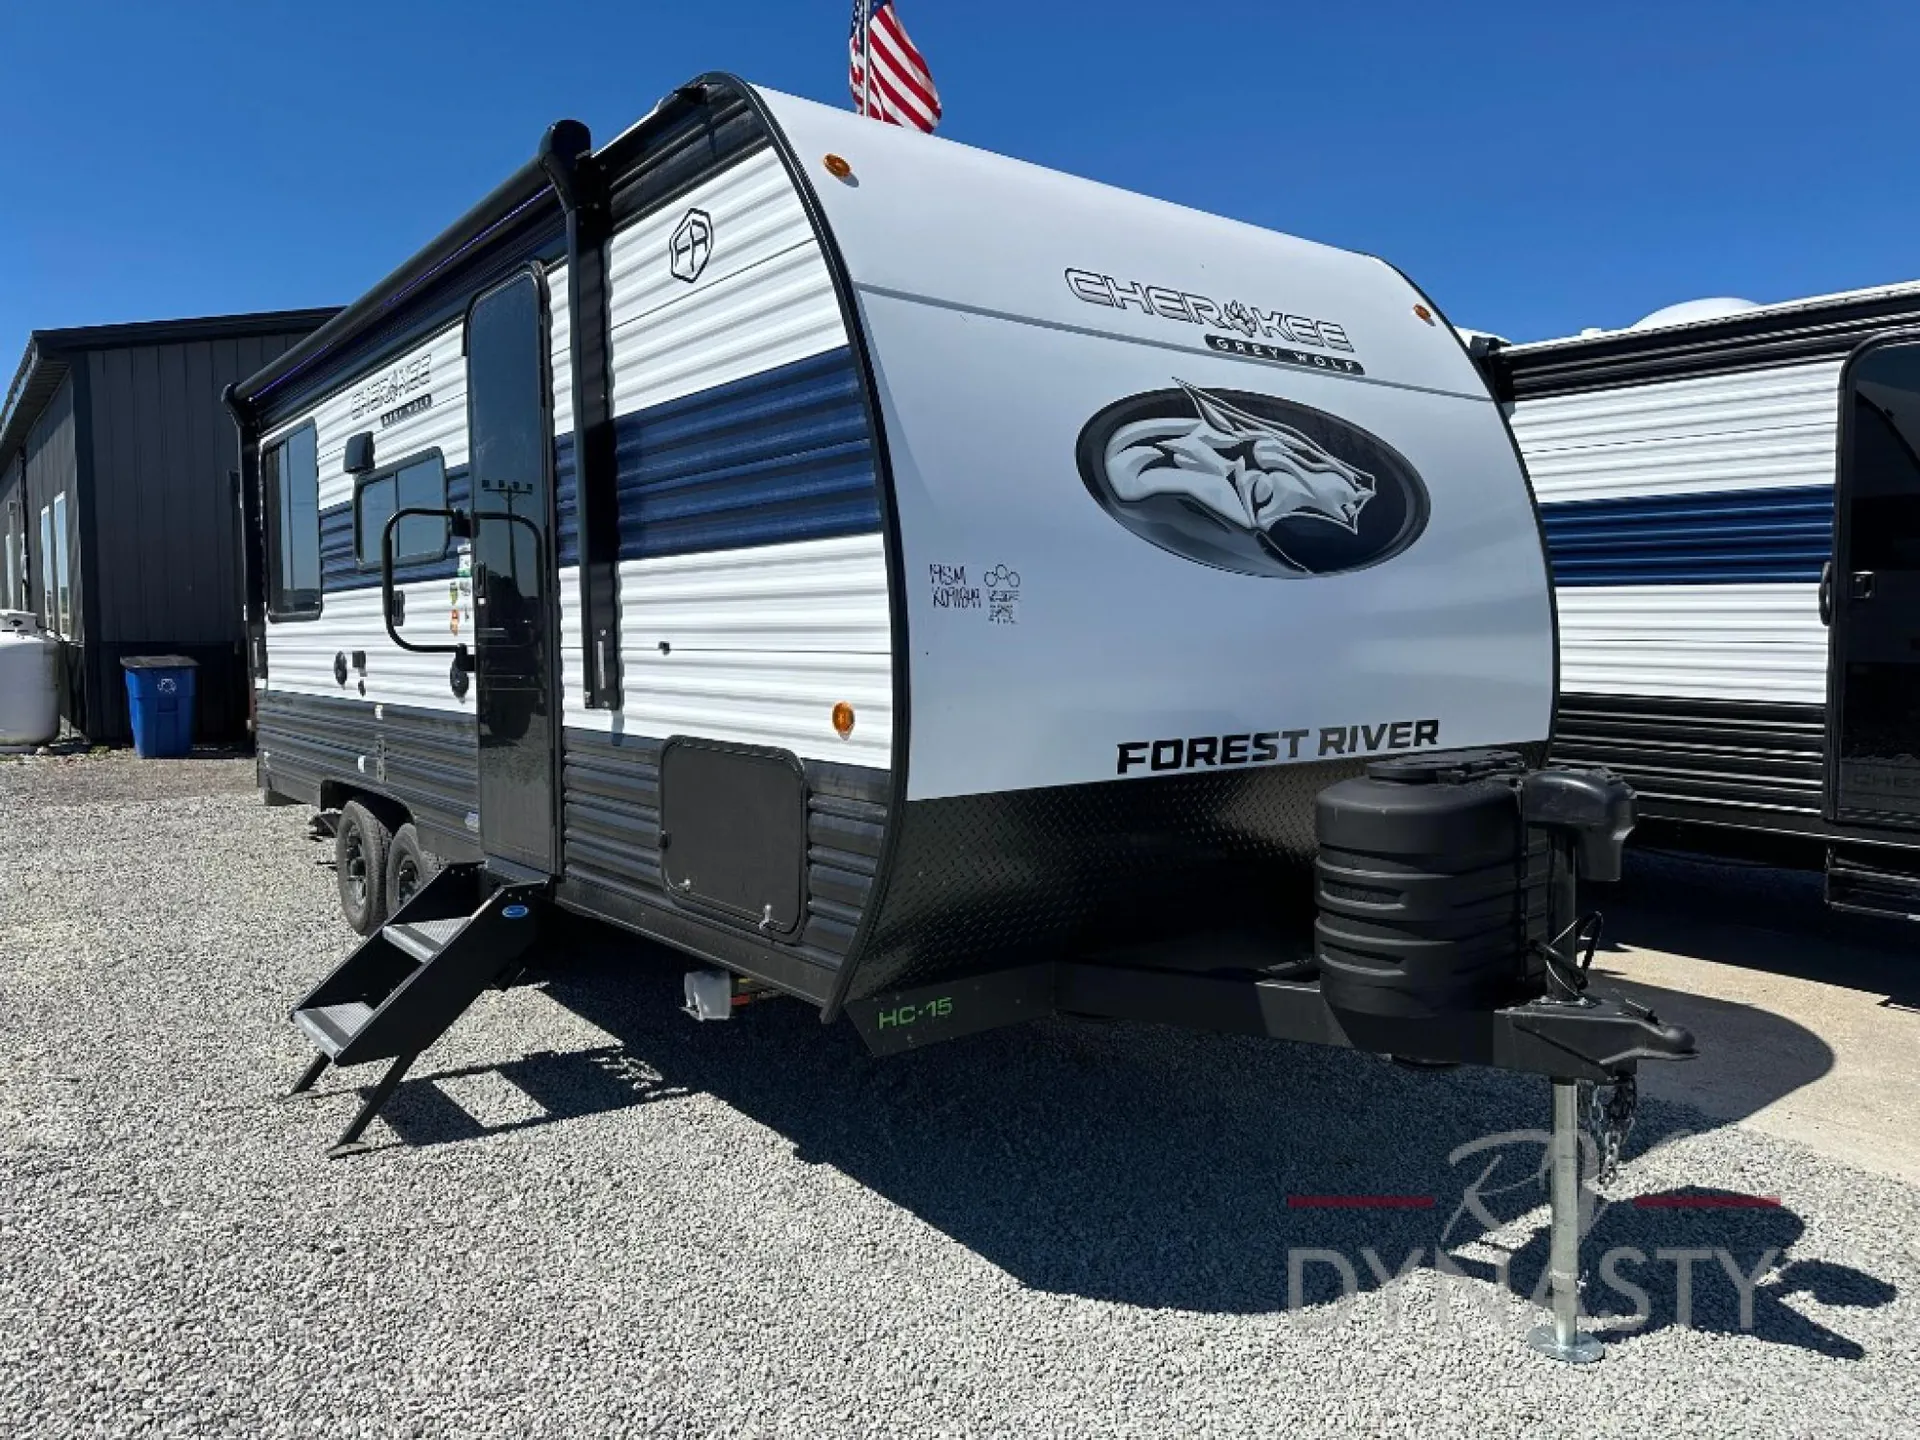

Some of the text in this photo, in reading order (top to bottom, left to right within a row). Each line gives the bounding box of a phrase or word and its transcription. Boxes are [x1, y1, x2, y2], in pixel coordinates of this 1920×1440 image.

[1064, 267, 1355, 353] CHEROKEE
[1215, 338, 1355, 373] GREY WOLF
[1116, 719, 1440, 775] FOREST RIVER
